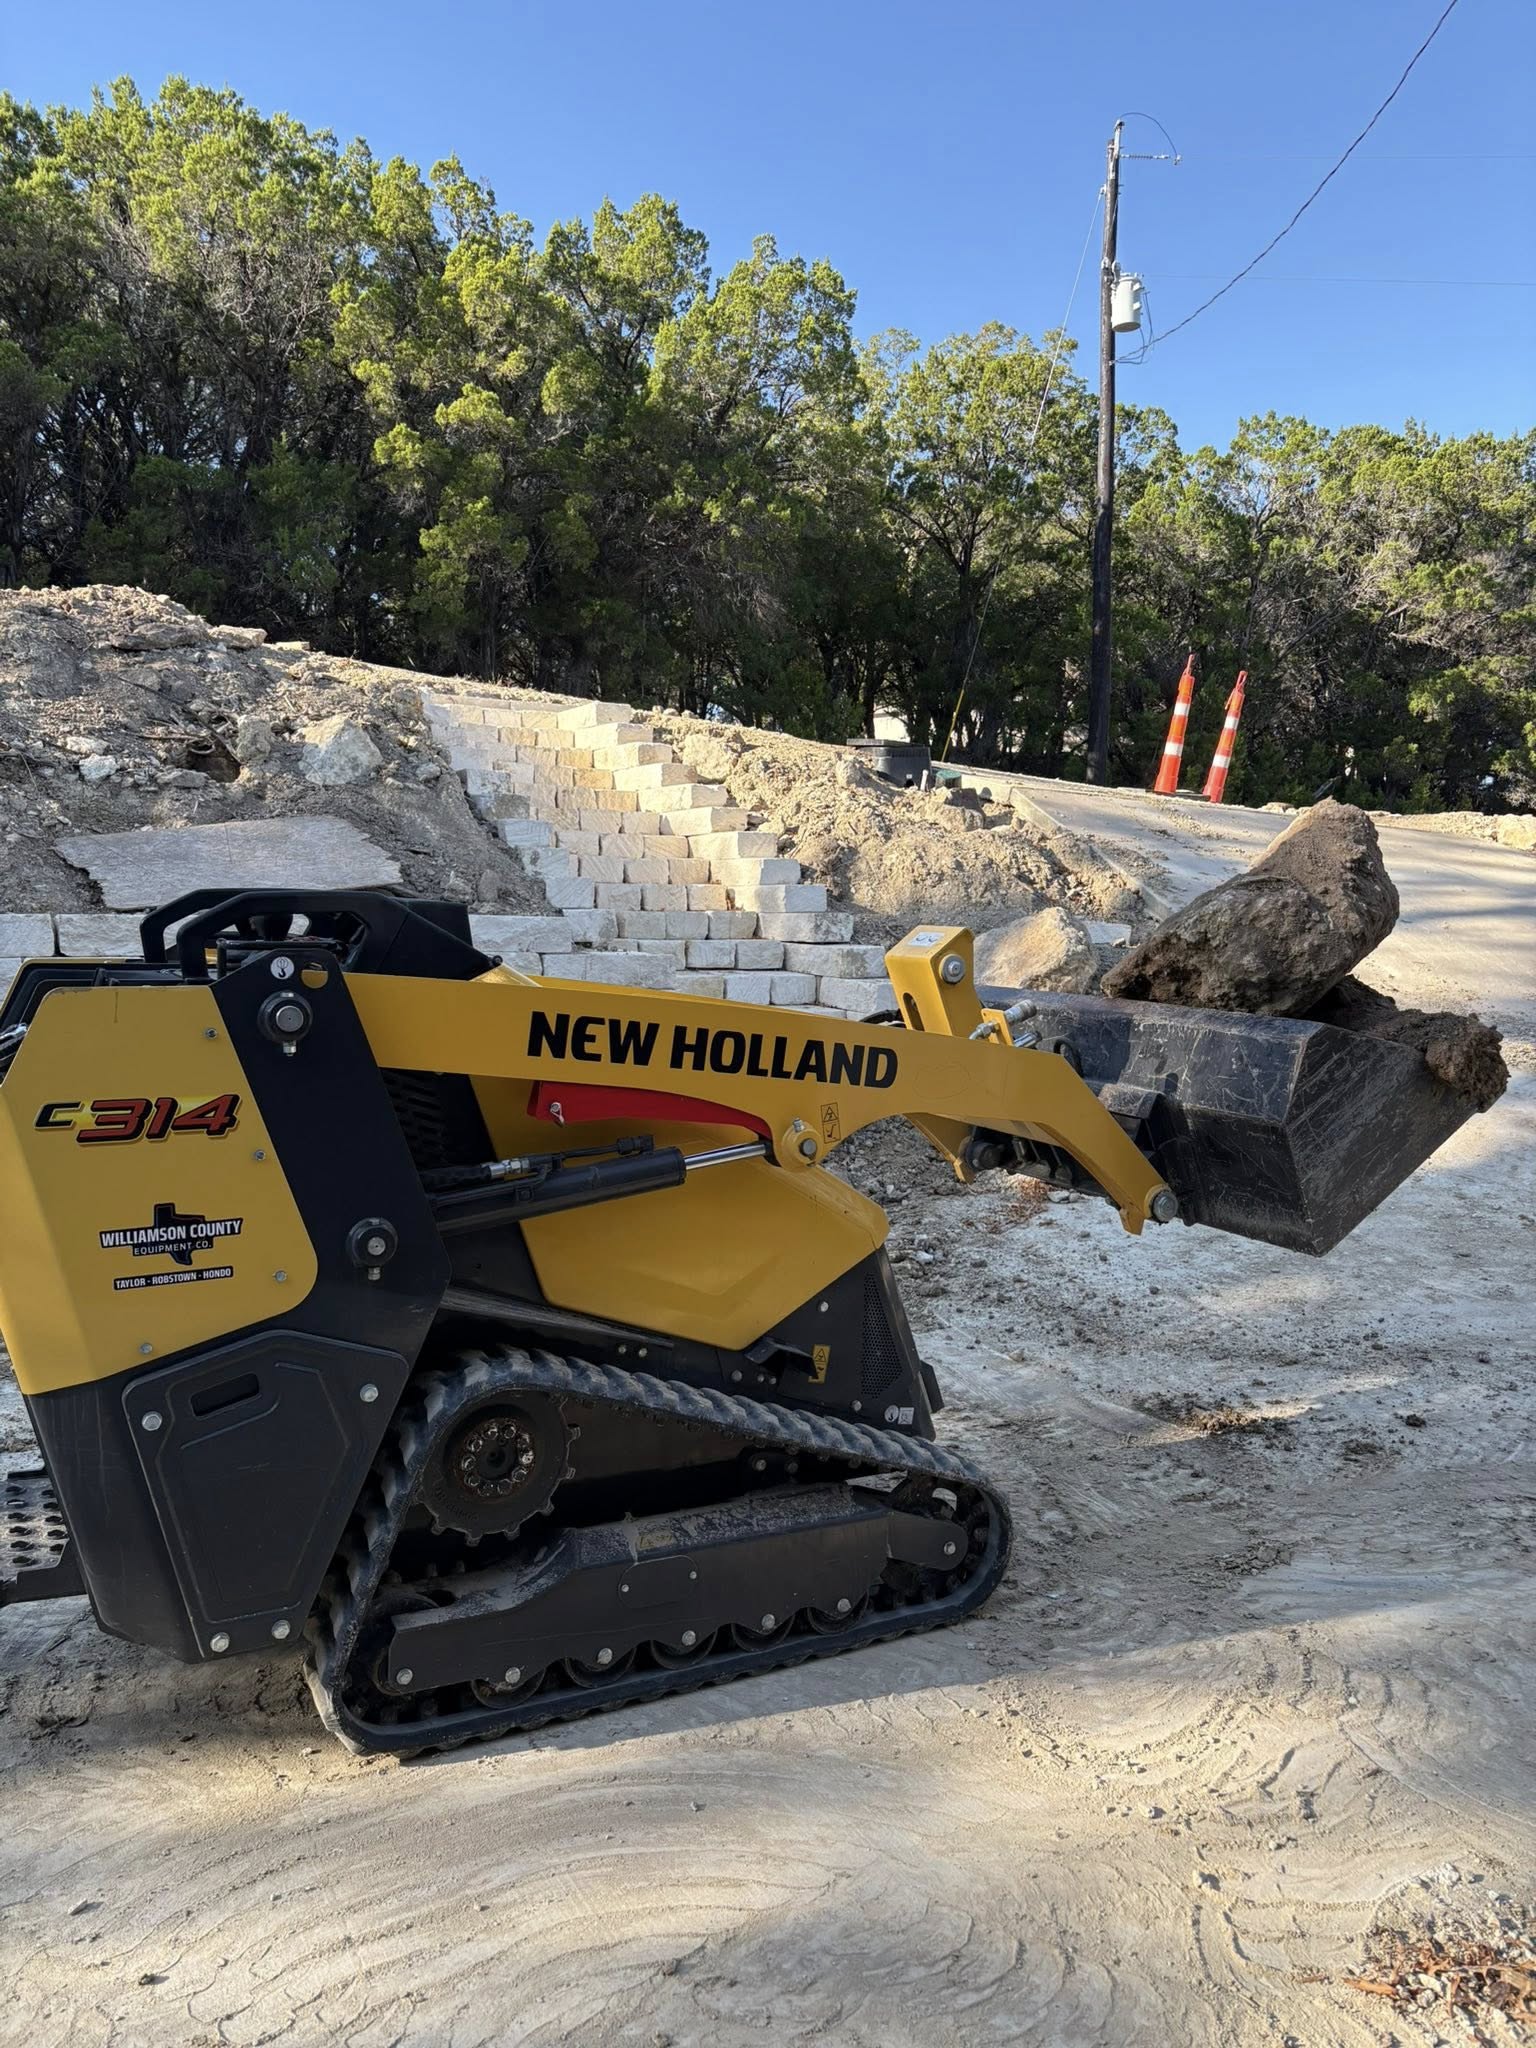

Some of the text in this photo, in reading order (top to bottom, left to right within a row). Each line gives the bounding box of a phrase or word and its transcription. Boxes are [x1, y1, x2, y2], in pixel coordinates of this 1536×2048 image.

[527, 1010, 898, 1089] NEW HOLLAND
[35, 1094, 240, 1143] C314
[101, 1220, 241, 1247] WILLIAMSON COUNTY
[134, 1240, 212, 1255] EQUIPMENT CO.
[115, 1275, 146, 1289] TAYLOR
[152, 1271, 197, 1284] ROBSTOWN
[203, 1268, 232, 1279] HONDO
